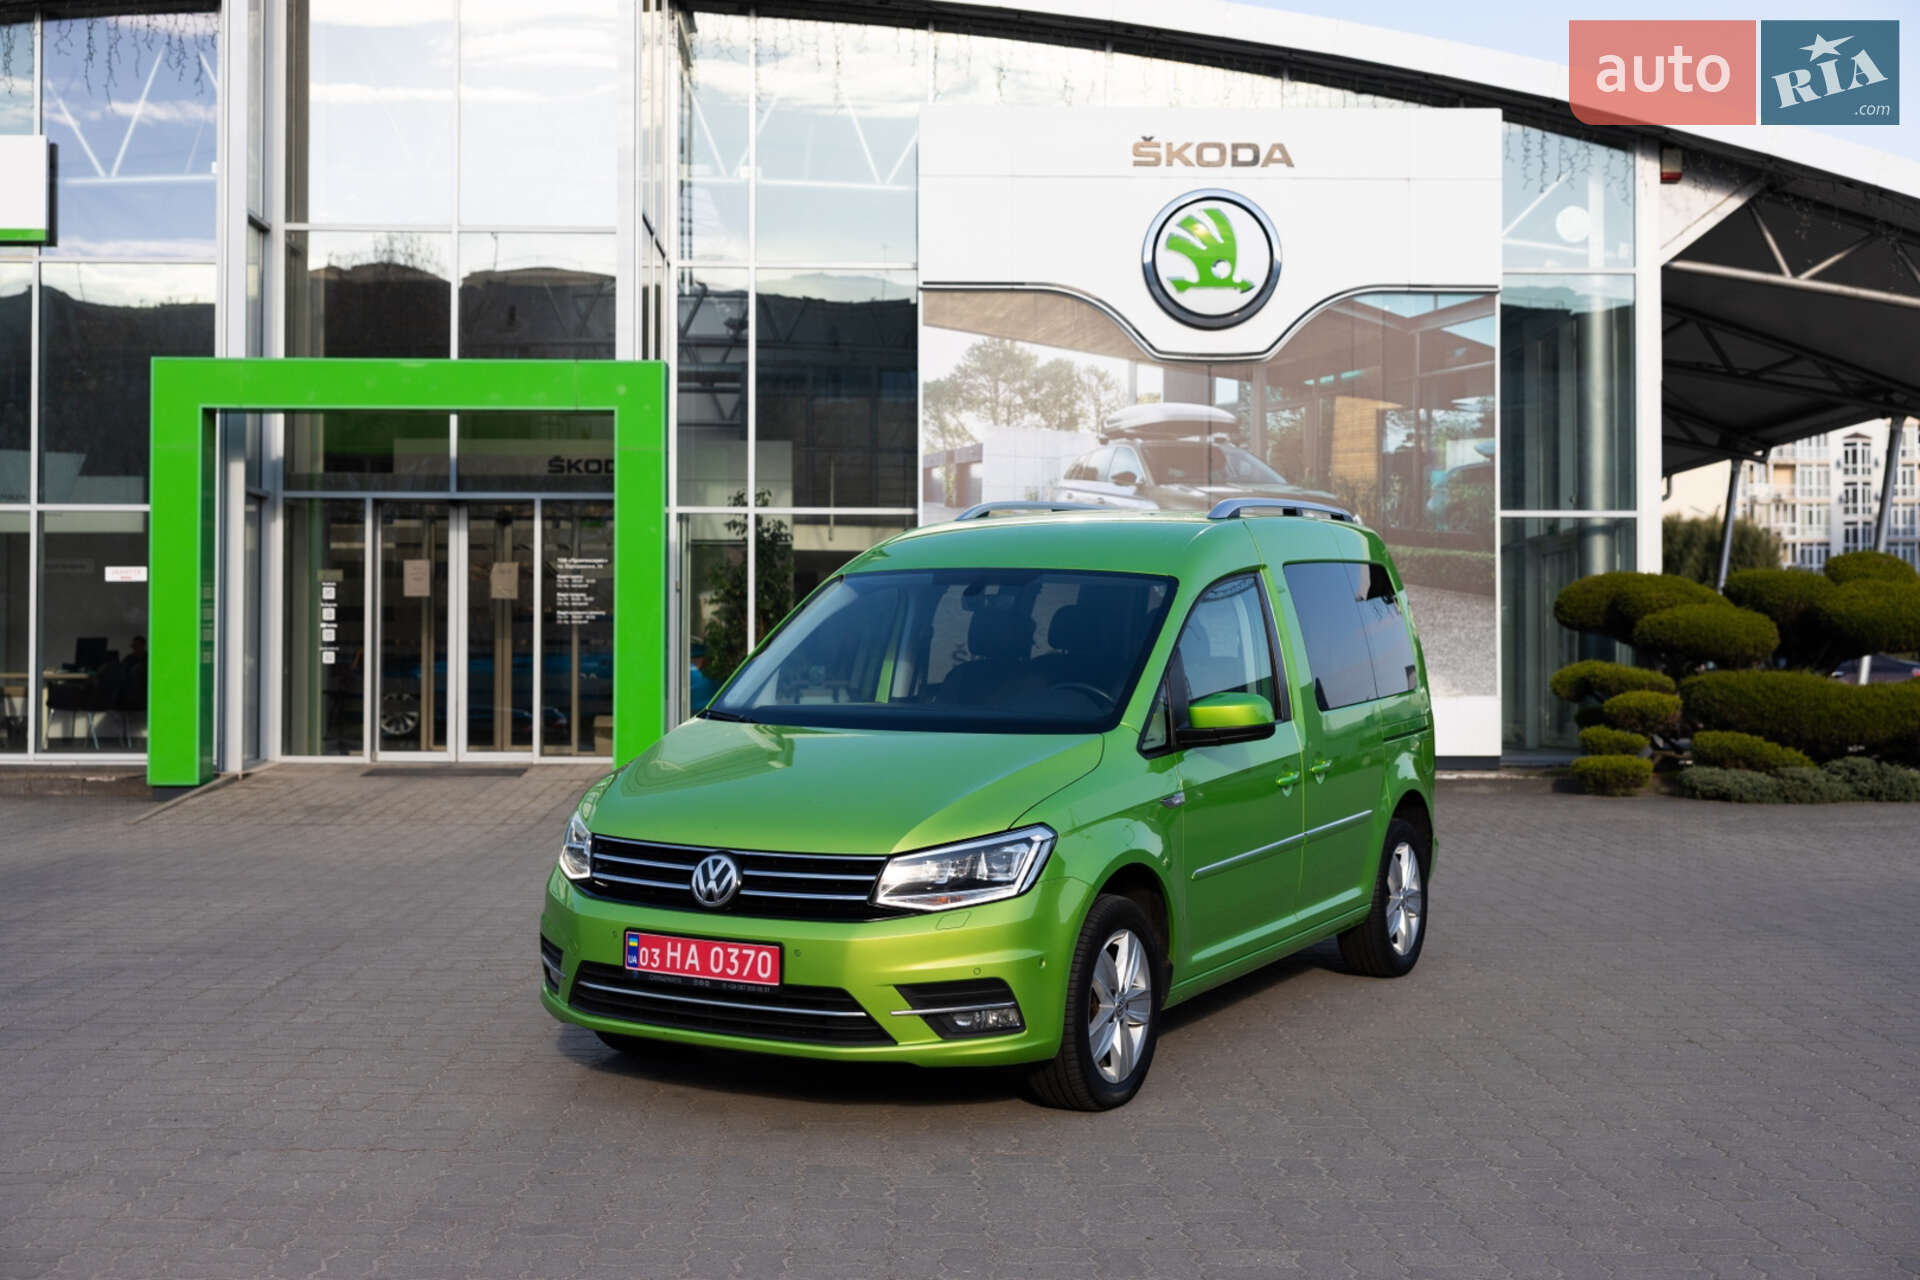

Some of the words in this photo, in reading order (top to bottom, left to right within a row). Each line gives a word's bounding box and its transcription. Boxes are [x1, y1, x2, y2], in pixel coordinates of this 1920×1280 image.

[1132, 136, 1296, 168] ŠKODA
[627, 954, 638, 964] UA
[639, 947, 661, 968] 03
[666, 942, 700, 972] HA
[710, 946, 772, 979] 0370
